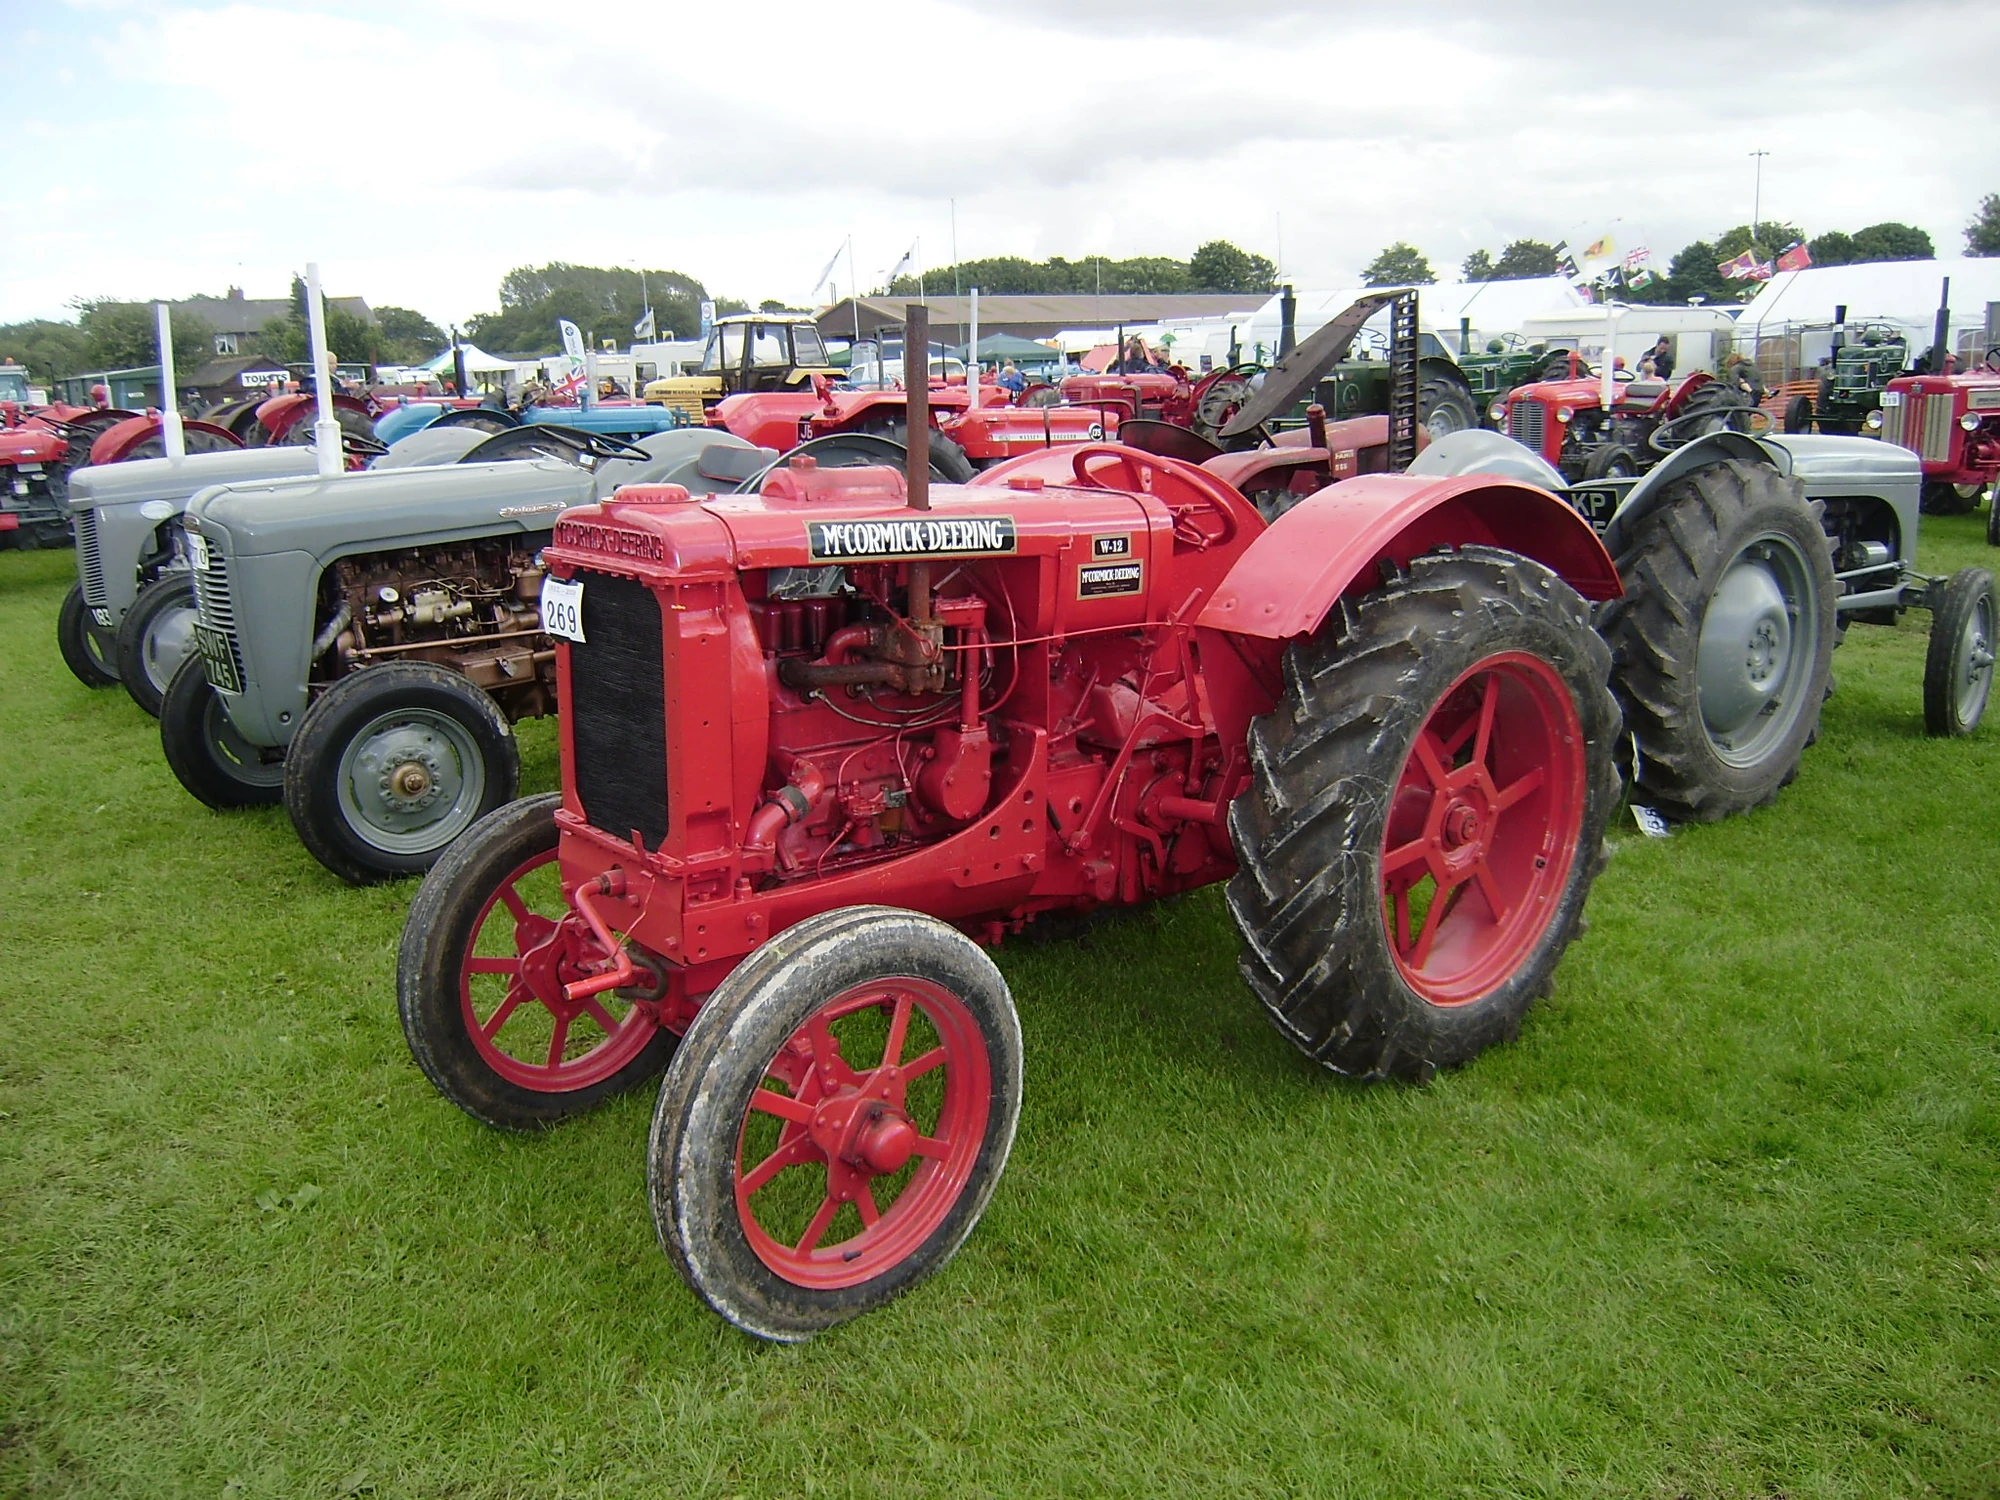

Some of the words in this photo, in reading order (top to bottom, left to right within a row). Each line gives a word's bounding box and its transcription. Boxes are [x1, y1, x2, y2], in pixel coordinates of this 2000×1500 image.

[547, 600, 577, 634] 269
[197, 626, 226, 660] SWF
[206, 658, 233, 689] 745
